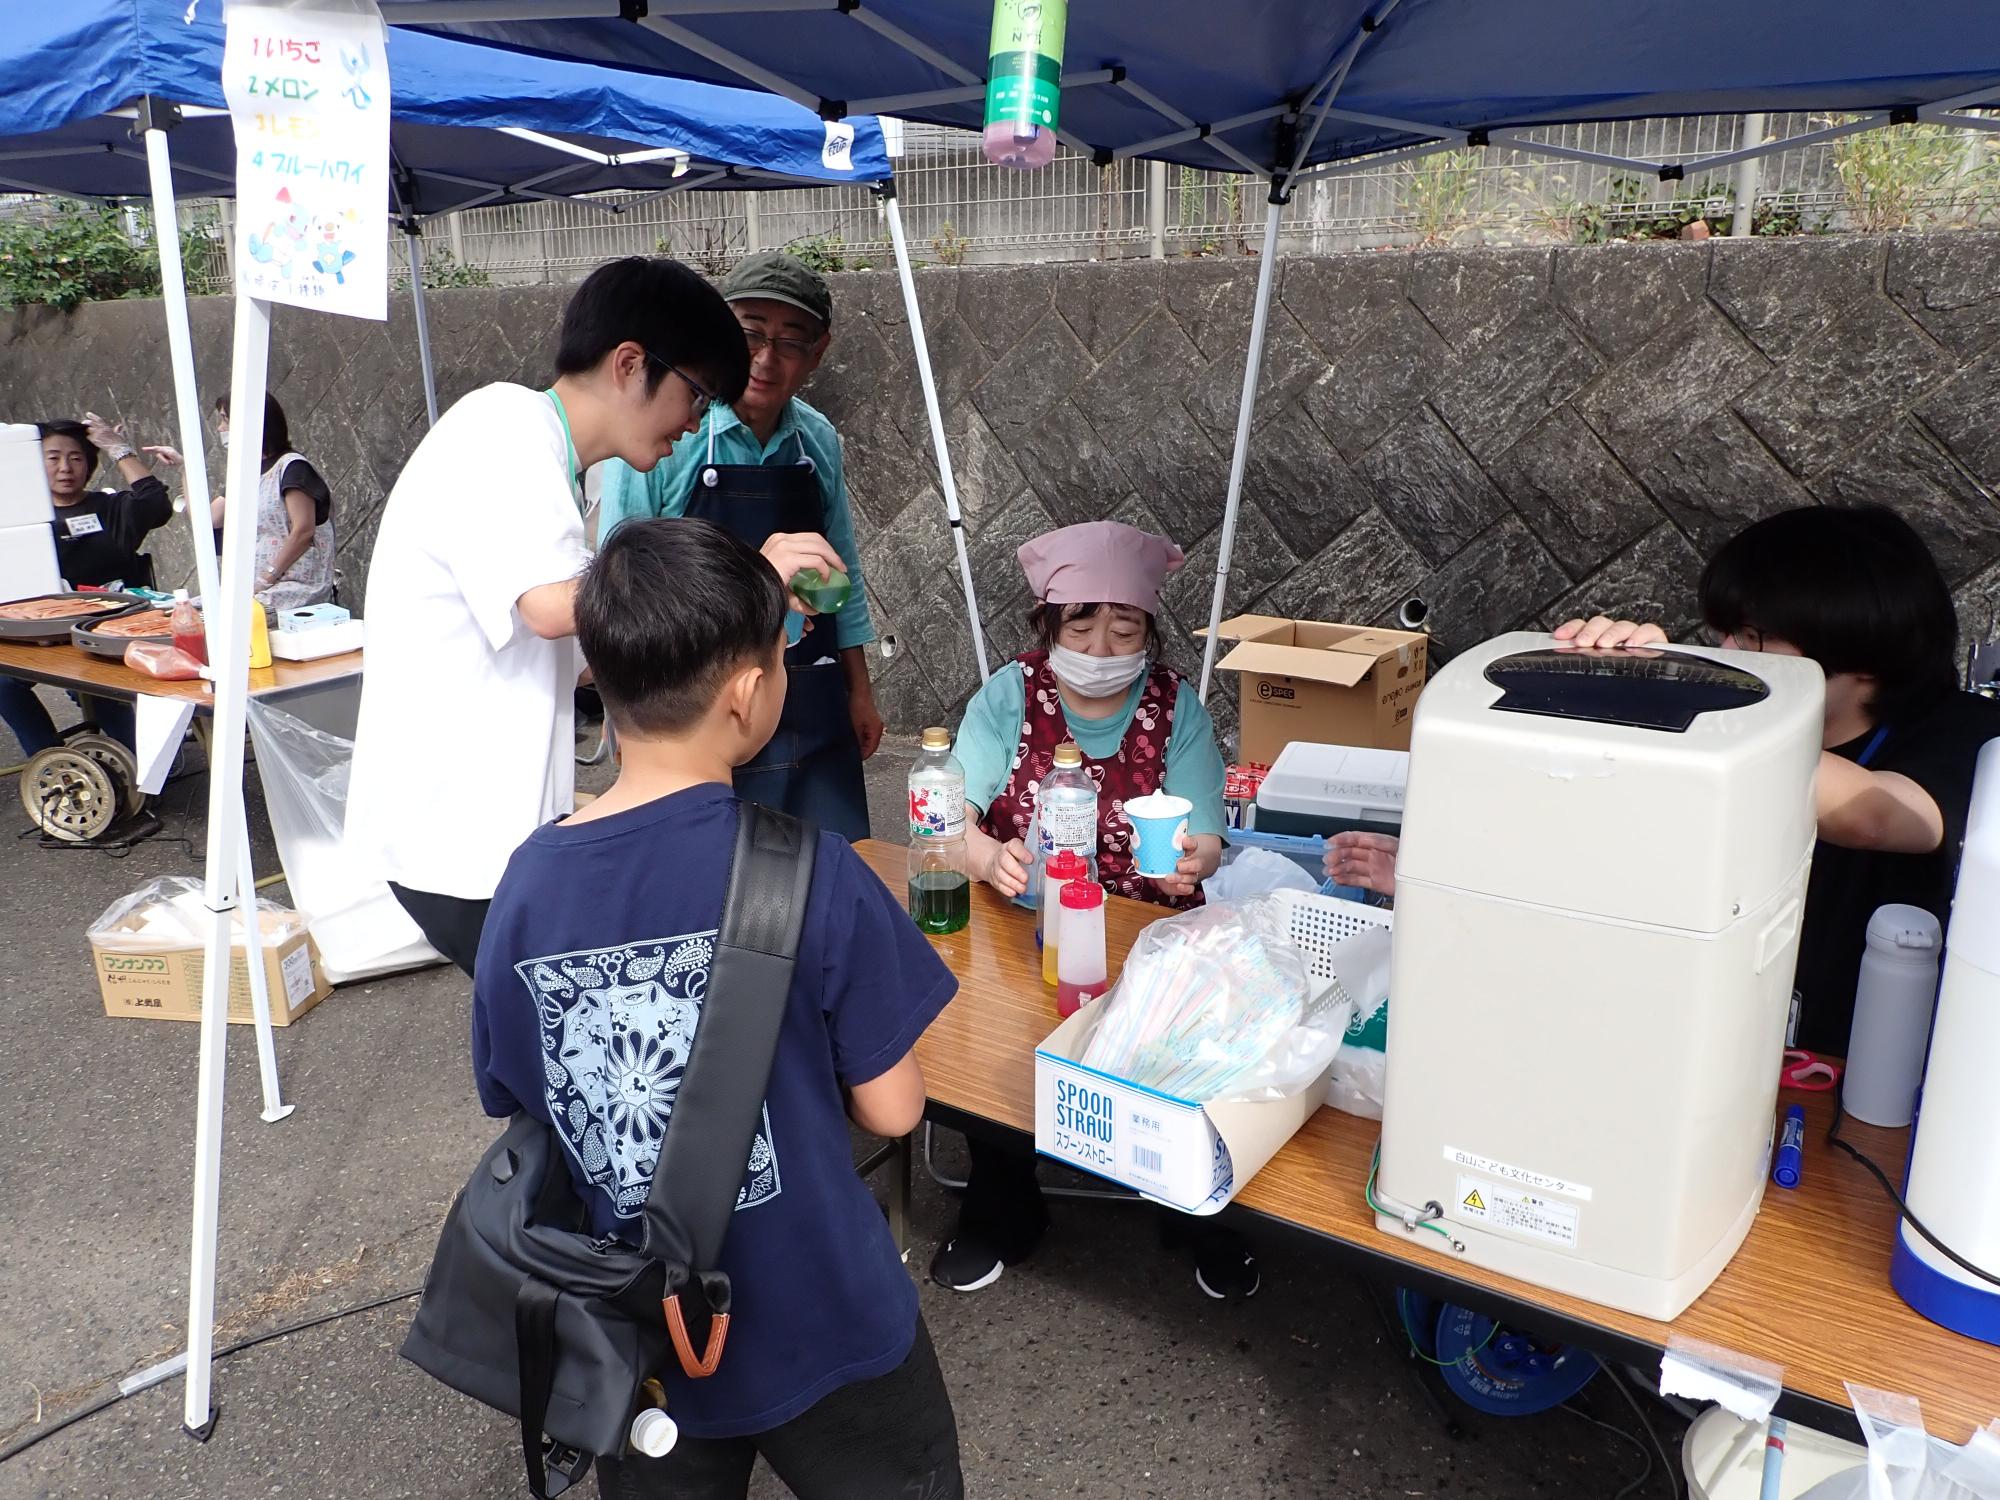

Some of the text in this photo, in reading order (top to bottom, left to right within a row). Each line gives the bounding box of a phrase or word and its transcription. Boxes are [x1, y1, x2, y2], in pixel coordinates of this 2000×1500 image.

[267, 37, 321, 64] いちご
[265, 77, 319, 101] メロン
[104, 956, 165, 971] マンナンママ
[1057, 1078, 1113, 1121] SPOON
[1057, 1103, 1112, 1143] STRAW
[1132, 1113, 1160, 1132] 業務用
[1056, 1131, 1113, 1165] スプーンストロー
[1455, 1151, 1577, 1192] 白山こども文化センター
